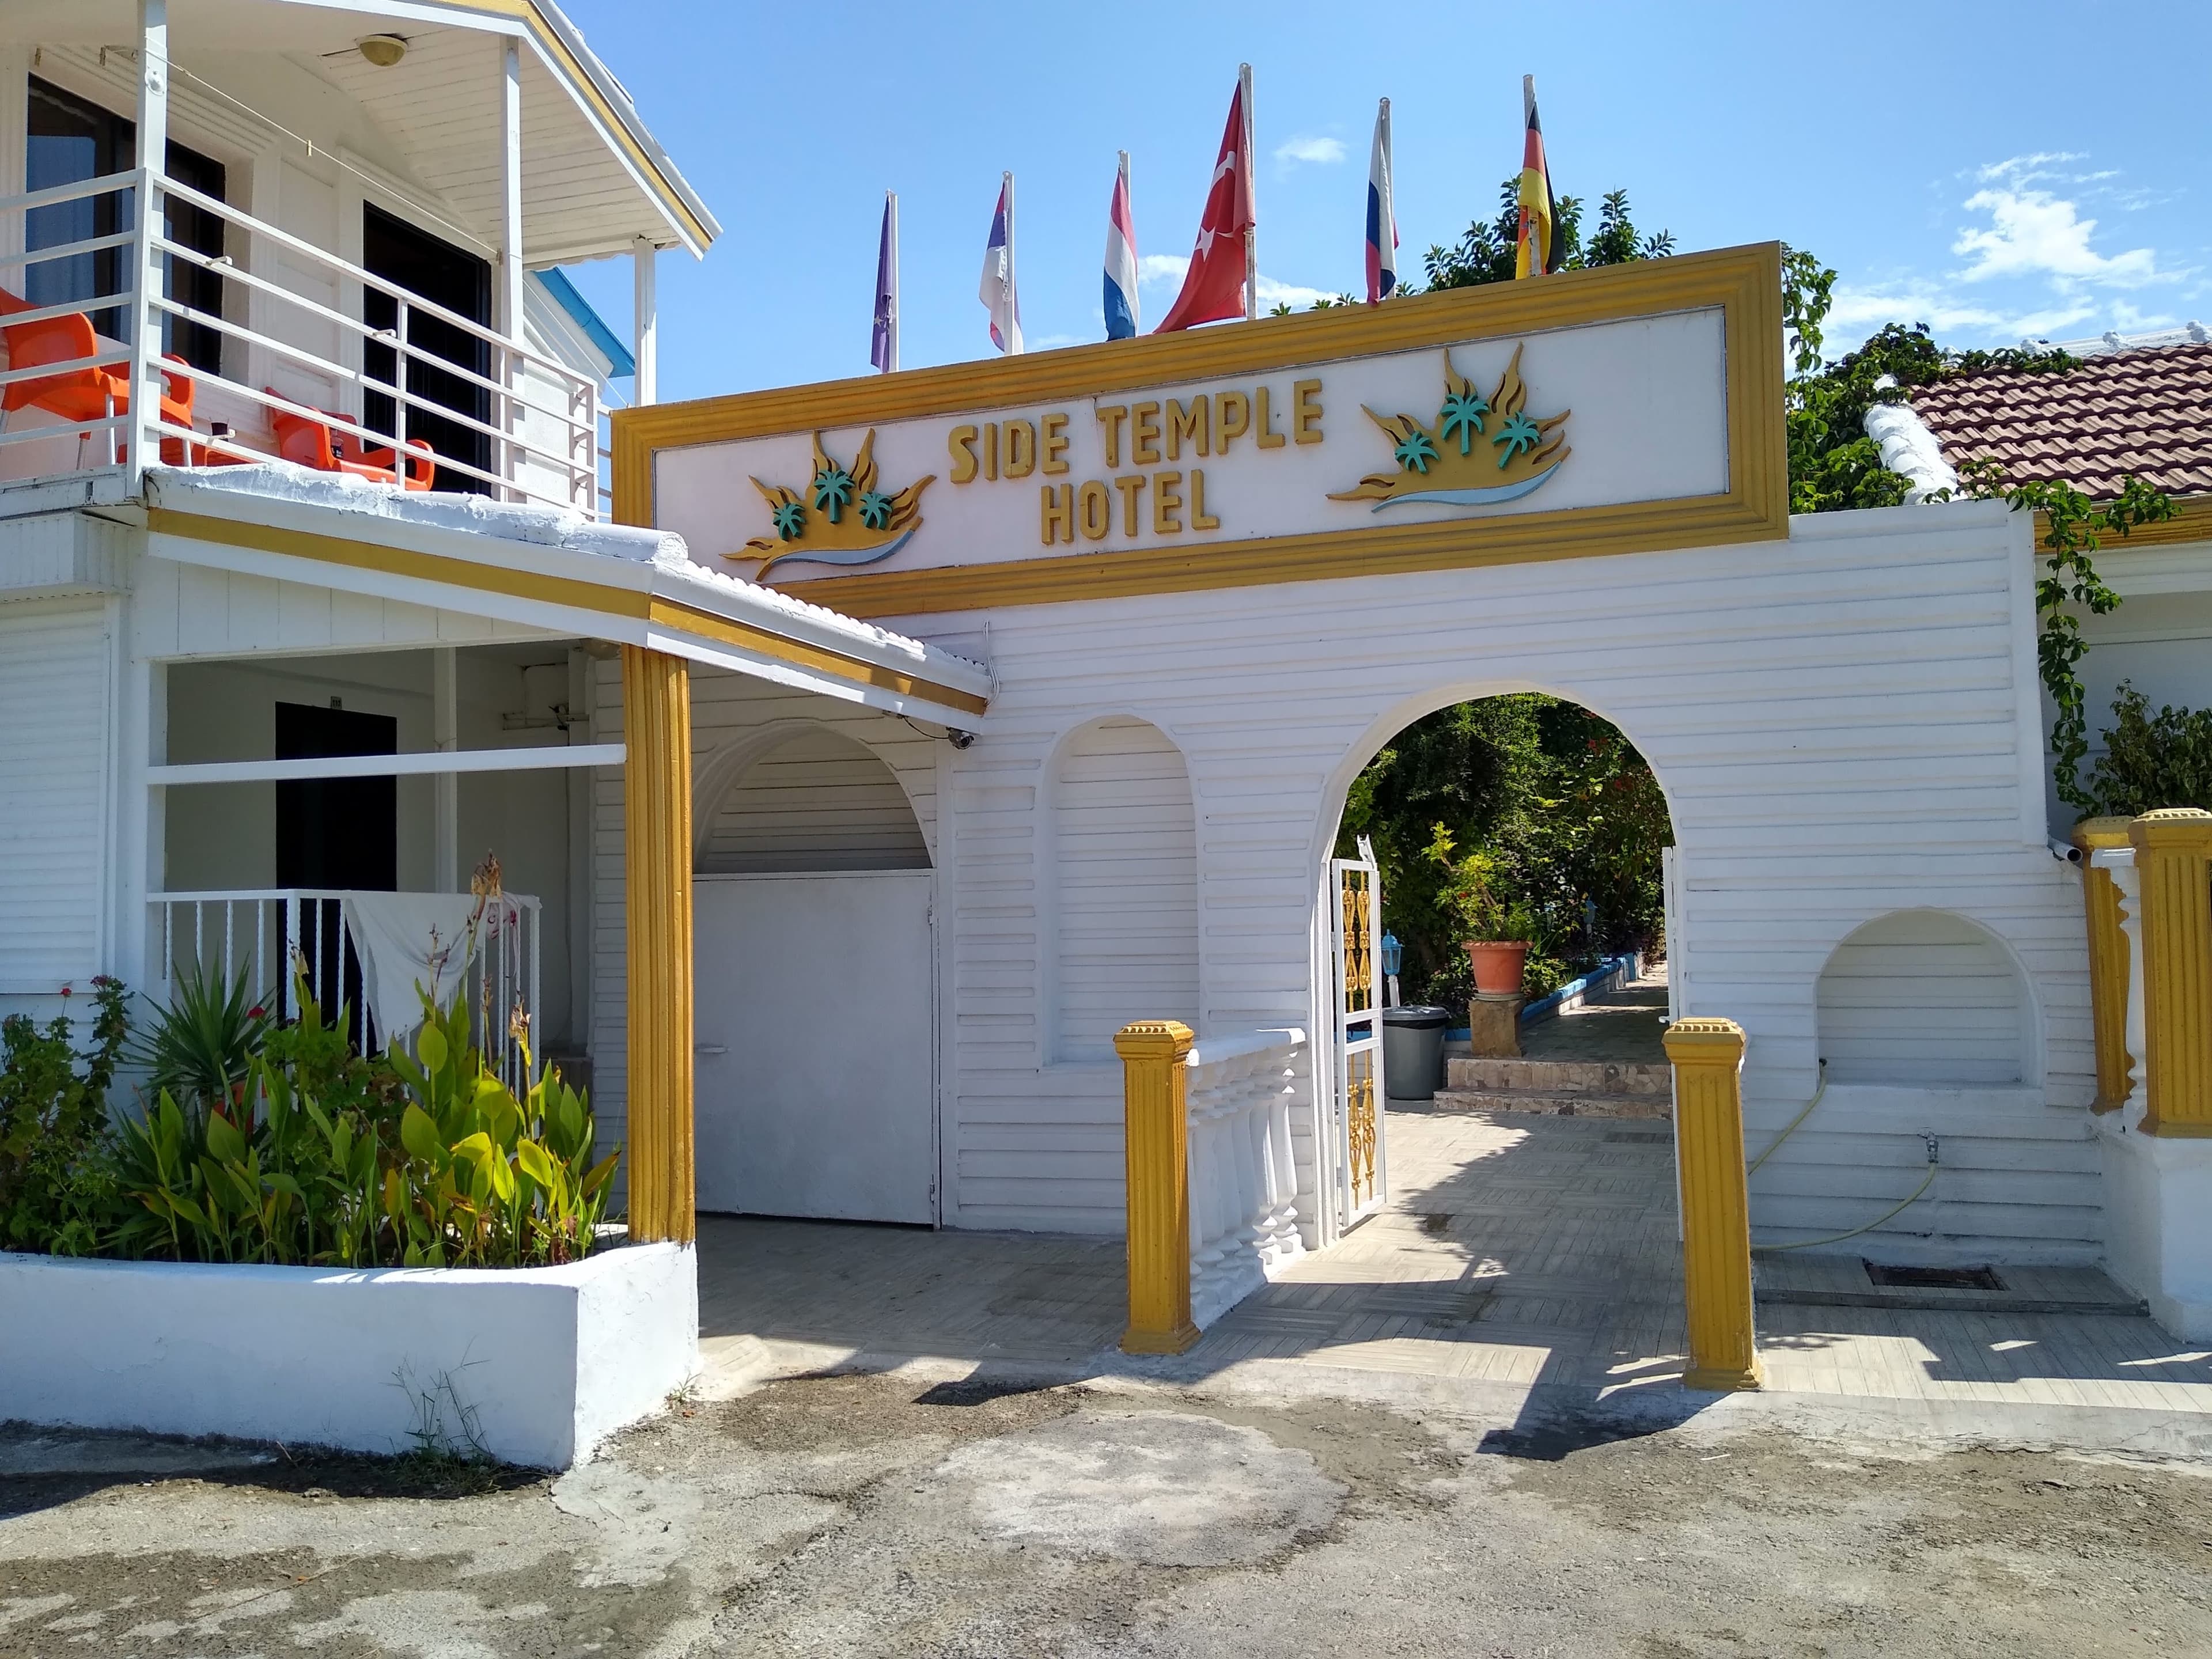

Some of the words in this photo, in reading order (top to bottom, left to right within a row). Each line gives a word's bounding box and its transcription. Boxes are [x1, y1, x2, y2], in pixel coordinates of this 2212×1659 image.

[948, 413, 1070, 484] SIDE
[1096, 378, 1323, 468] TEMPLE
[1041, 469, 1220, 546] HOTEL
